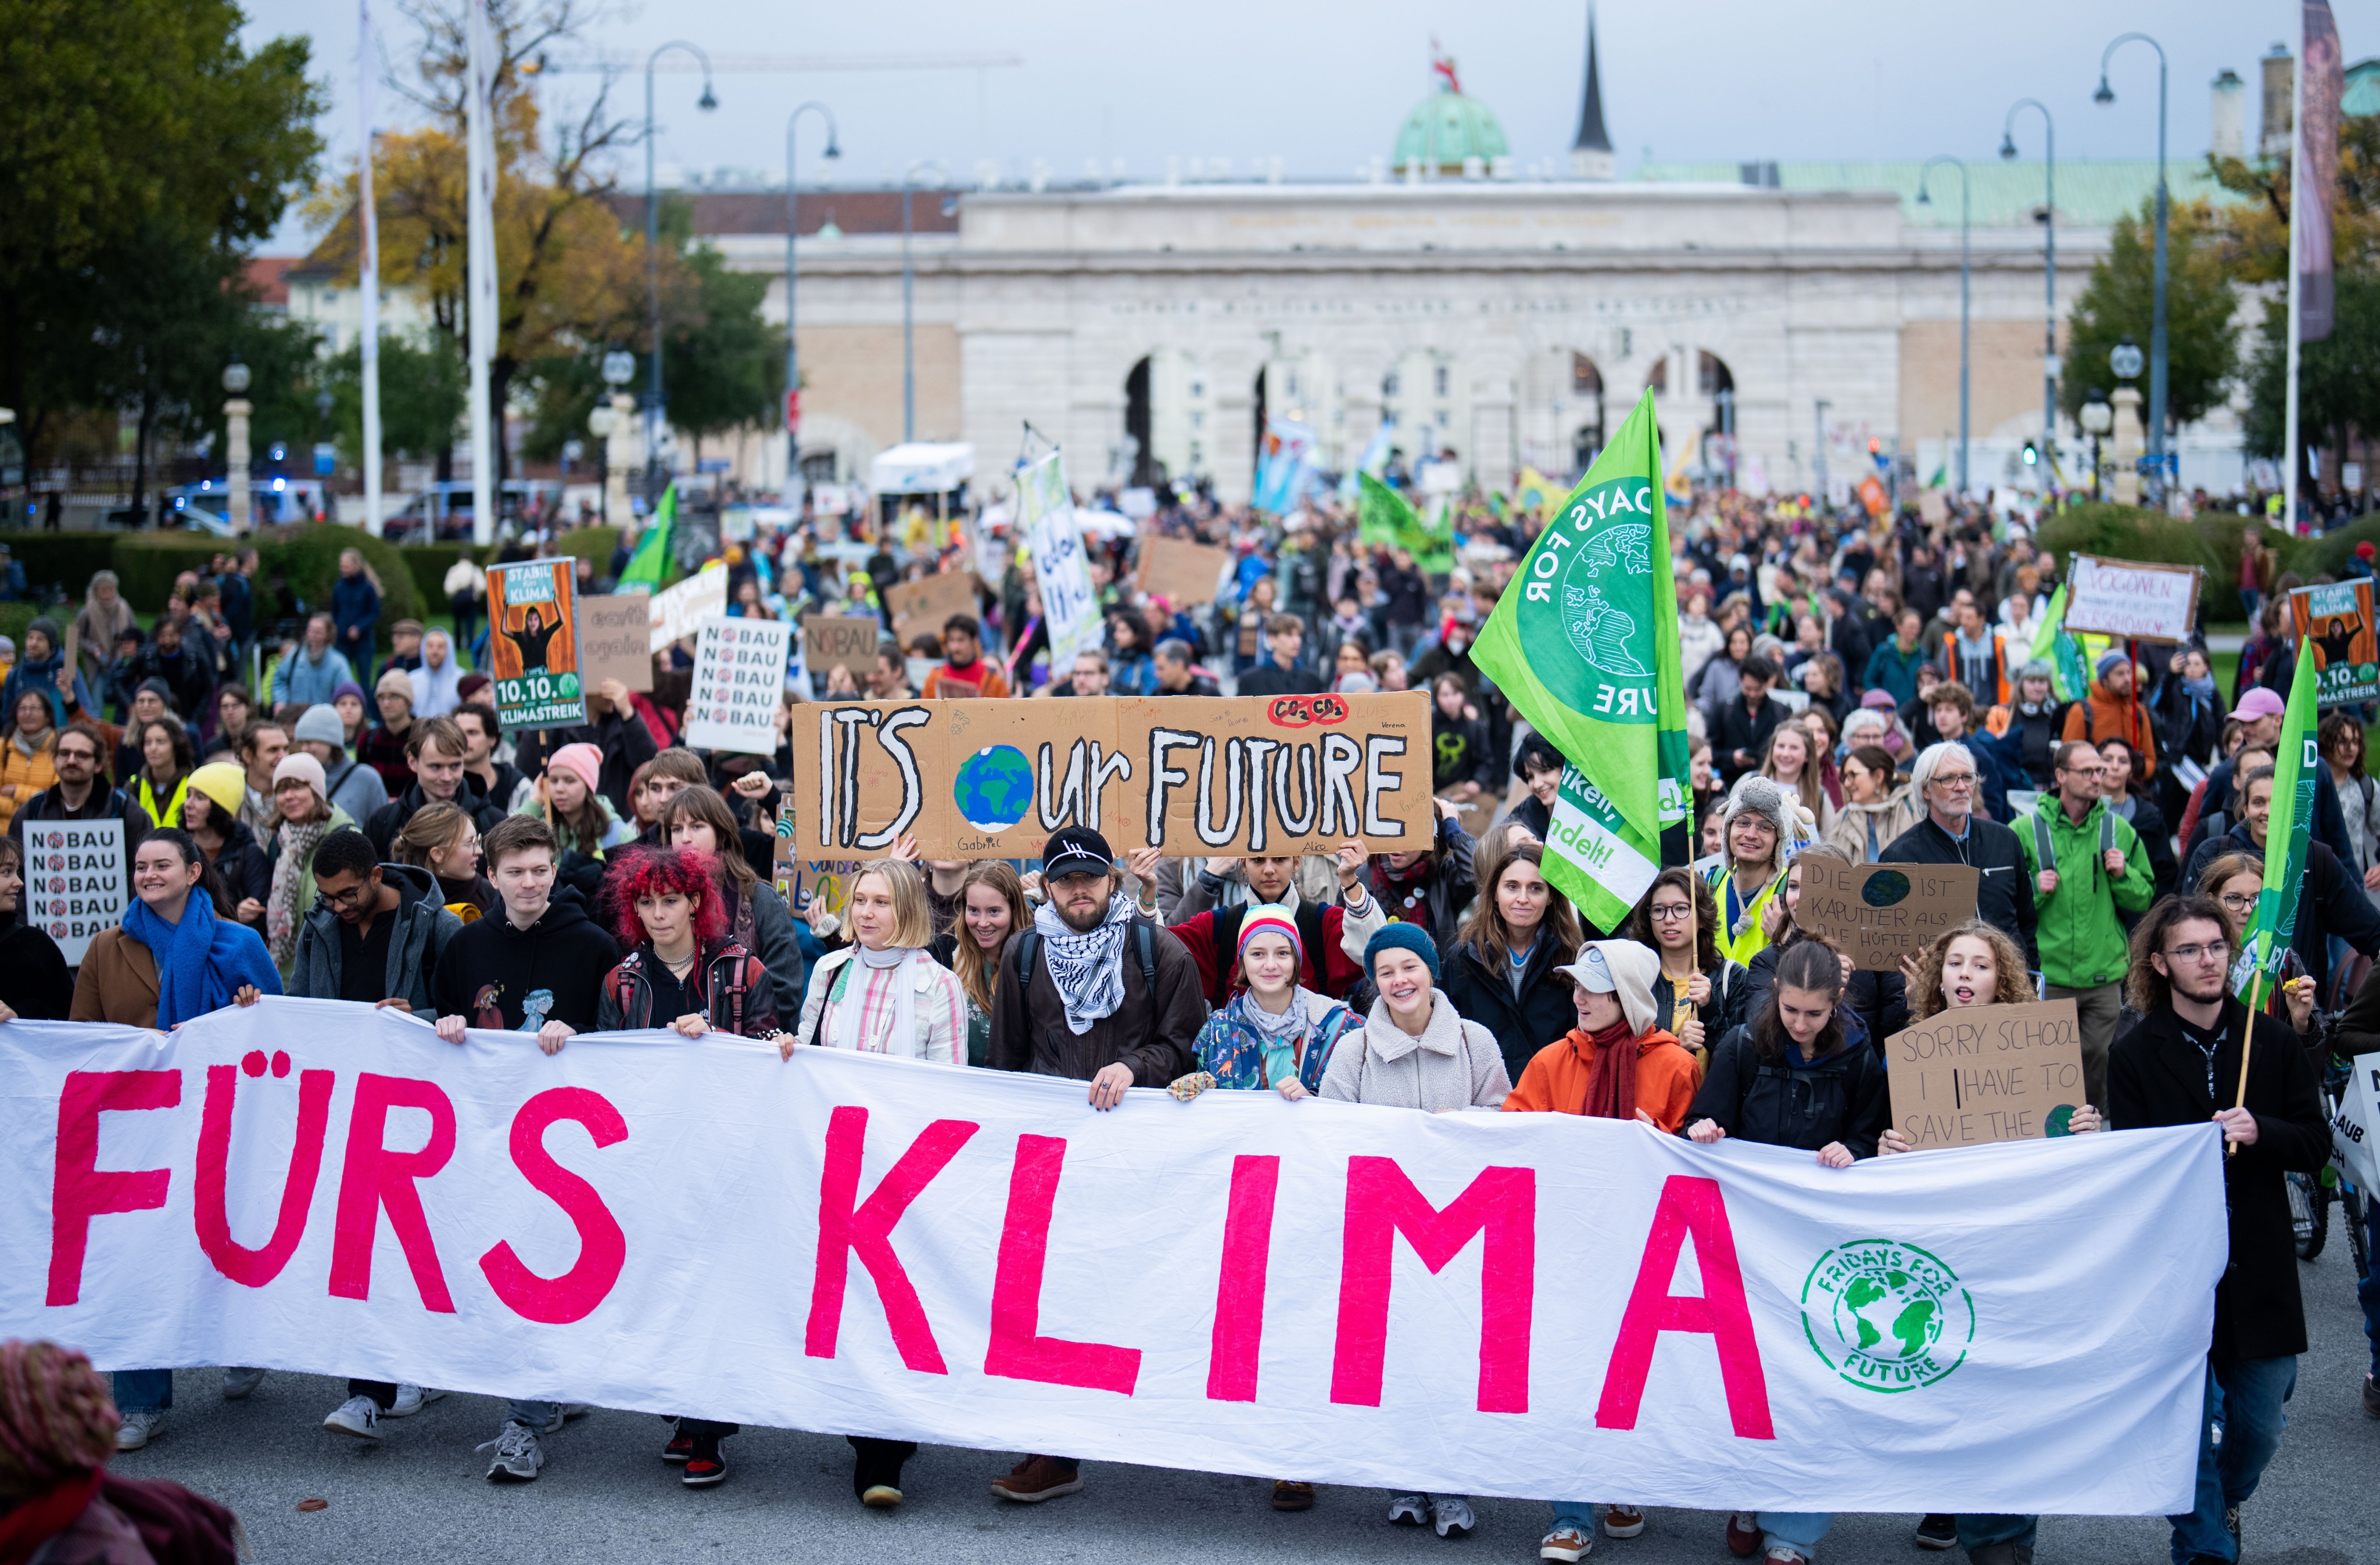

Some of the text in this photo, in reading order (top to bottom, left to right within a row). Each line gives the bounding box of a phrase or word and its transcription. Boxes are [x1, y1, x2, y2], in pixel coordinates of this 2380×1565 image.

[508, 564, 551, 583] STABIL
[510, 585, 550, 604] KLIMA
[500, 702, 582, 725] KLIMASTREIK
[1357, 705, 1390, 718] LUIS
[820, 705, 931, 850] IT'S
[1145, 727, 1407, 852] FUTURE
[862, 764, 888, 778] Clara
[1399, 798, 1420, 813] Paula
[958, 836, 1001, 850] Gabriel
[1302, 841, 1328, 852] Alice
[1811, 864, 1955, 896] DIE IST
[1812, 897, 1948, 927] KAPUTTER ALS
[1861, 932, 1911, 947] HÜFTE
[1902, 1020, 2079, 1061] SORRY SCHOOL
[1963, 1067, 2026, 1101] HAVE
[2040, 1063, 2078, 1091] TO
[1905, 1110, 2034, 1145] SAVE THE
[45, 1049, 1777, 1439] FÜRS KLIMA
[1818, 1250, 1952, 1296] FRIDAYS FOR
[1844, 1354, 1940, 1381] FUTURE
